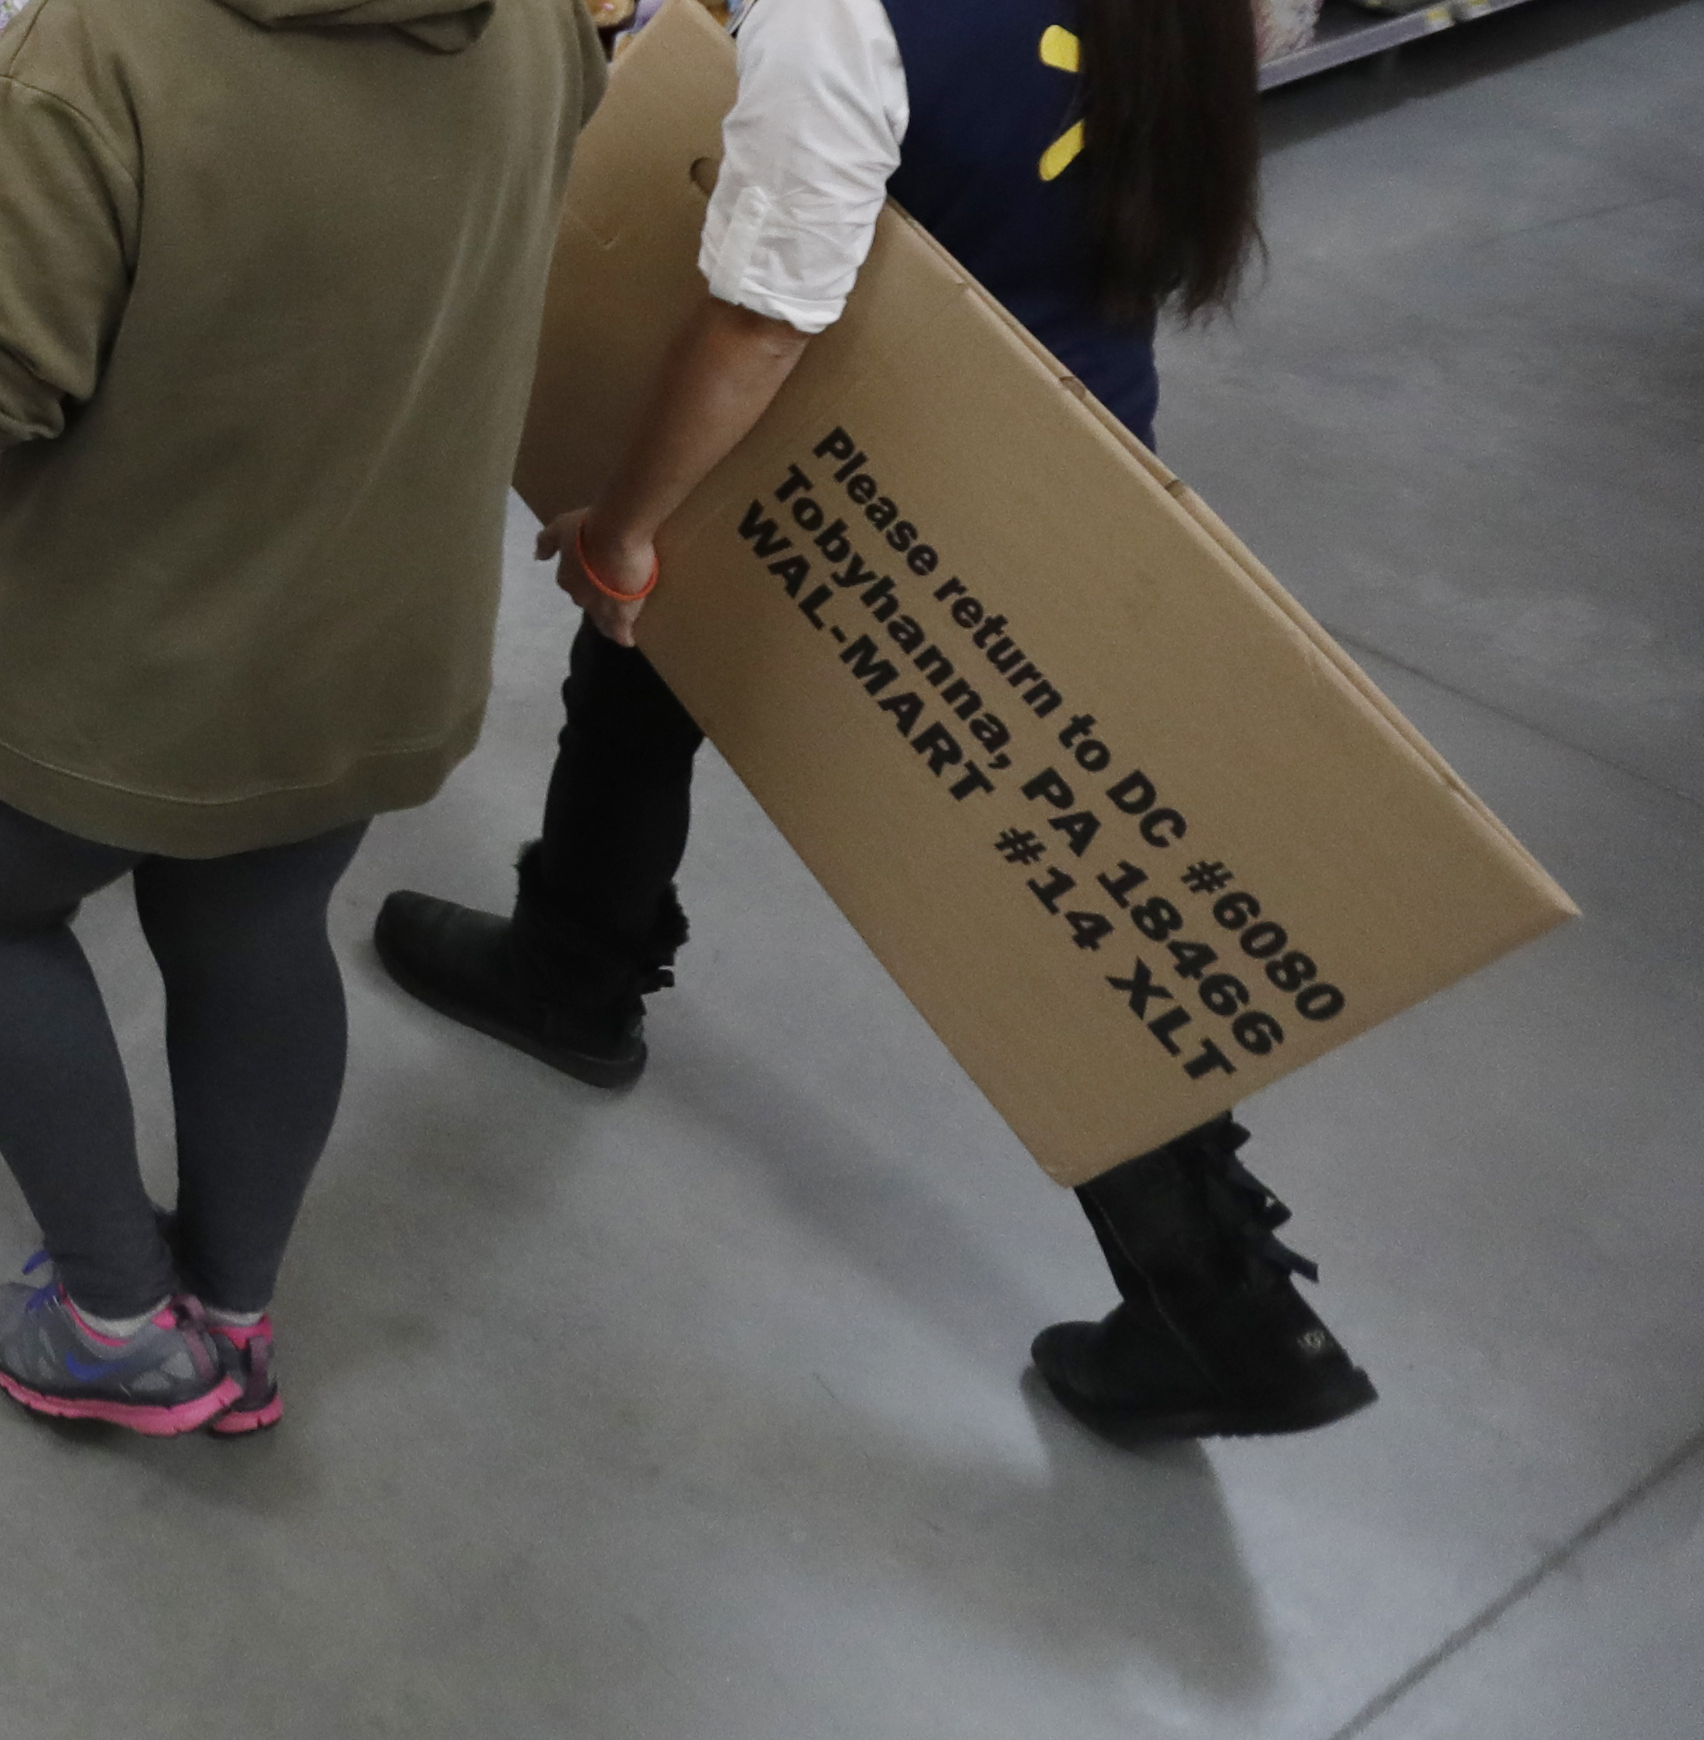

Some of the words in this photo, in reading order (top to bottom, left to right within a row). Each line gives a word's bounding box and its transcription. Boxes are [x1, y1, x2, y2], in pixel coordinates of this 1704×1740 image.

[736, 500, 996, 802] WAL-MART
[994, 826, 1115, 952] #14
[1105, 956, 1237, 1081] XLT
[770, 465, 1013, 772] Tobyhanna,
[1021, 767, 1102, 858] PA
[1096, 859, 1285, 1057] 18466
[813, 426, 939, 577] Please
[934, 575, 1066, 719] return
[1057, 713, 1112, 773] to
[1105, 769, 1188, 849] DC
[1180, 858, 1346, 1022] #6080
